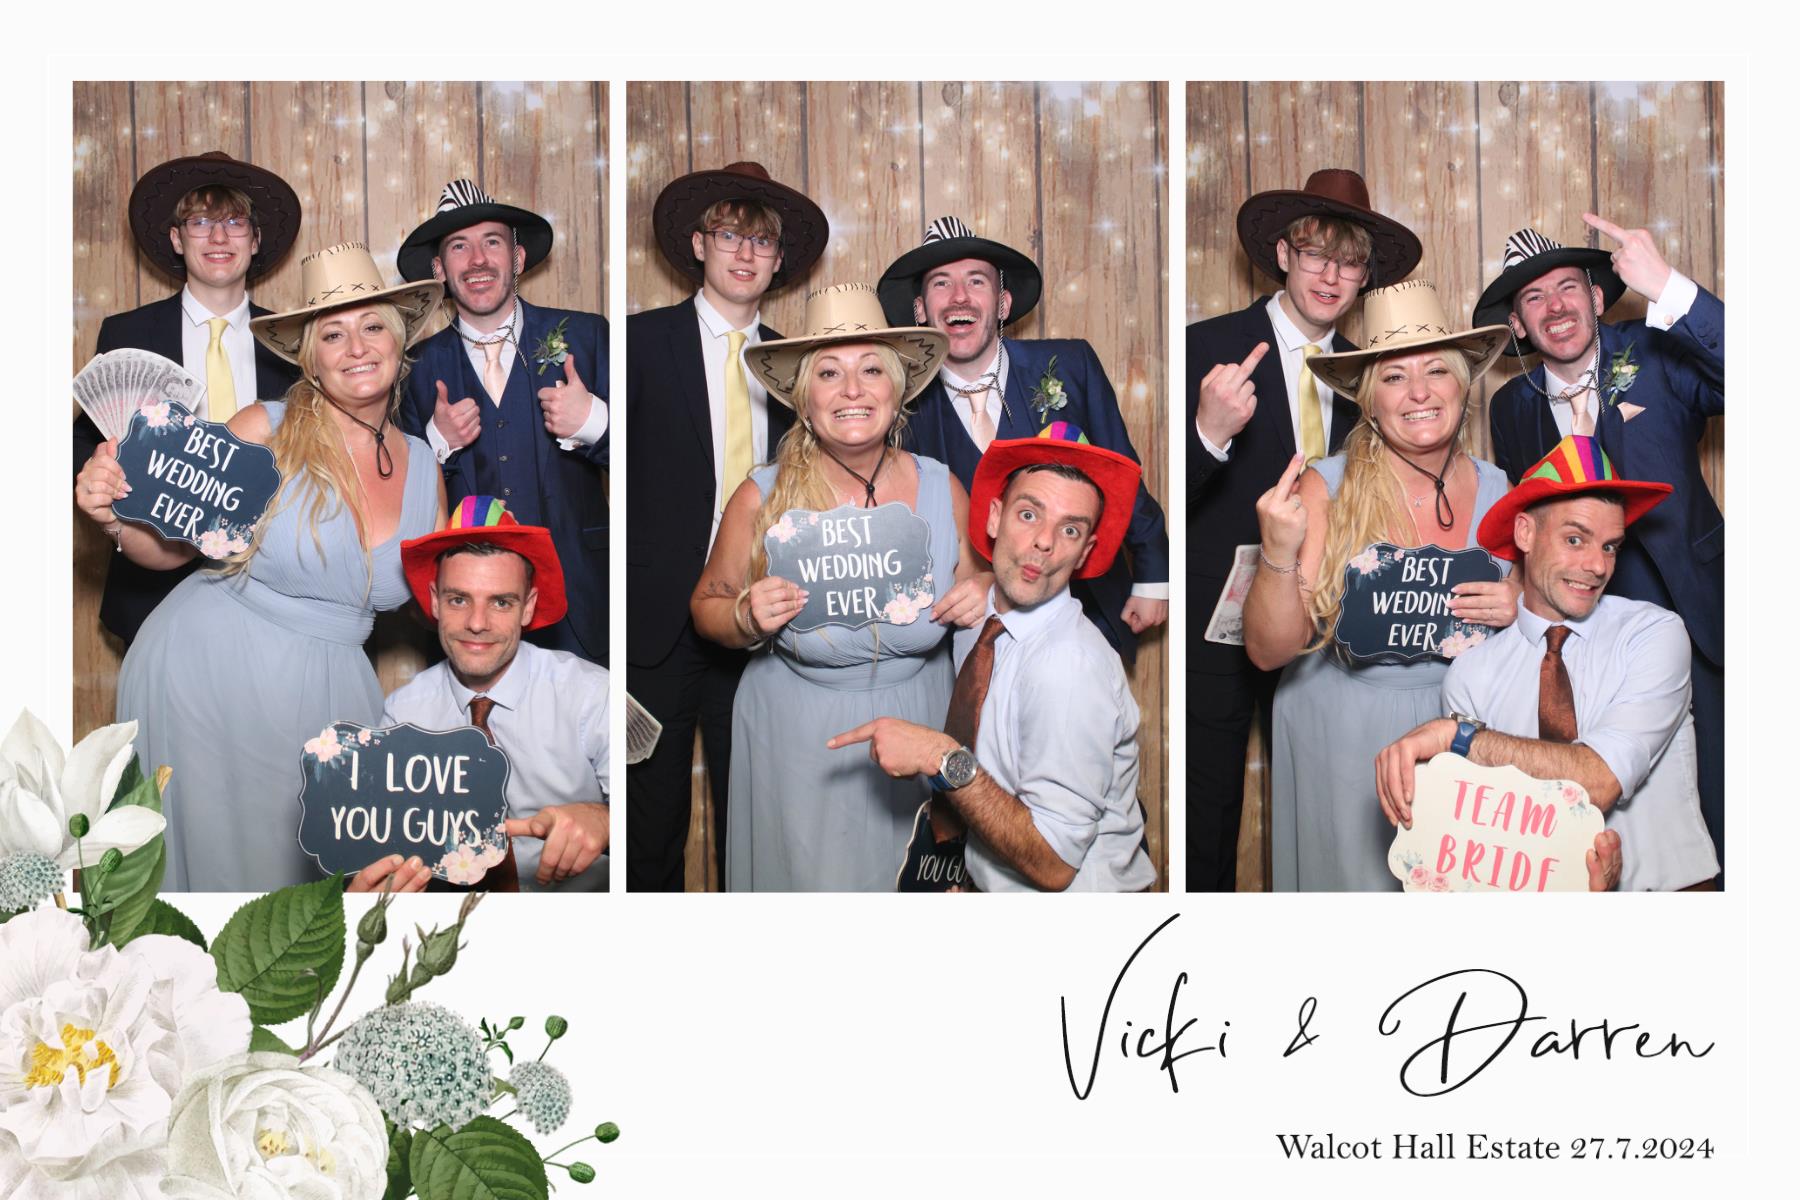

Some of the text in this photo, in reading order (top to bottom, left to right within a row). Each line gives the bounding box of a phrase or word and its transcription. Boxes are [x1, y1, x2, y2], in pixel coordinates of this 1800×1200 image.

[183, 426, 240, 472] BEST
[147, 449, 243, 512] WEDDING
[150, 493, 205, 538] EVER
[821, 515, 873, 549] BEST
[797, 549, 902, 584] WEDDING
[1401, 556, 1454, 587] BEST
[825, 586, 881, 619] EVER
[1372, 590, 1460, 617] WEDDIN
[1387, 622, 1437, 652] EVER
[350, 750, 470, 795] I LOVE
[1453, 779, 1559, 839] TEAM
[330, 806, 482, 848] YOU GUYS
[916, 854, 968, 884] YOU GU
